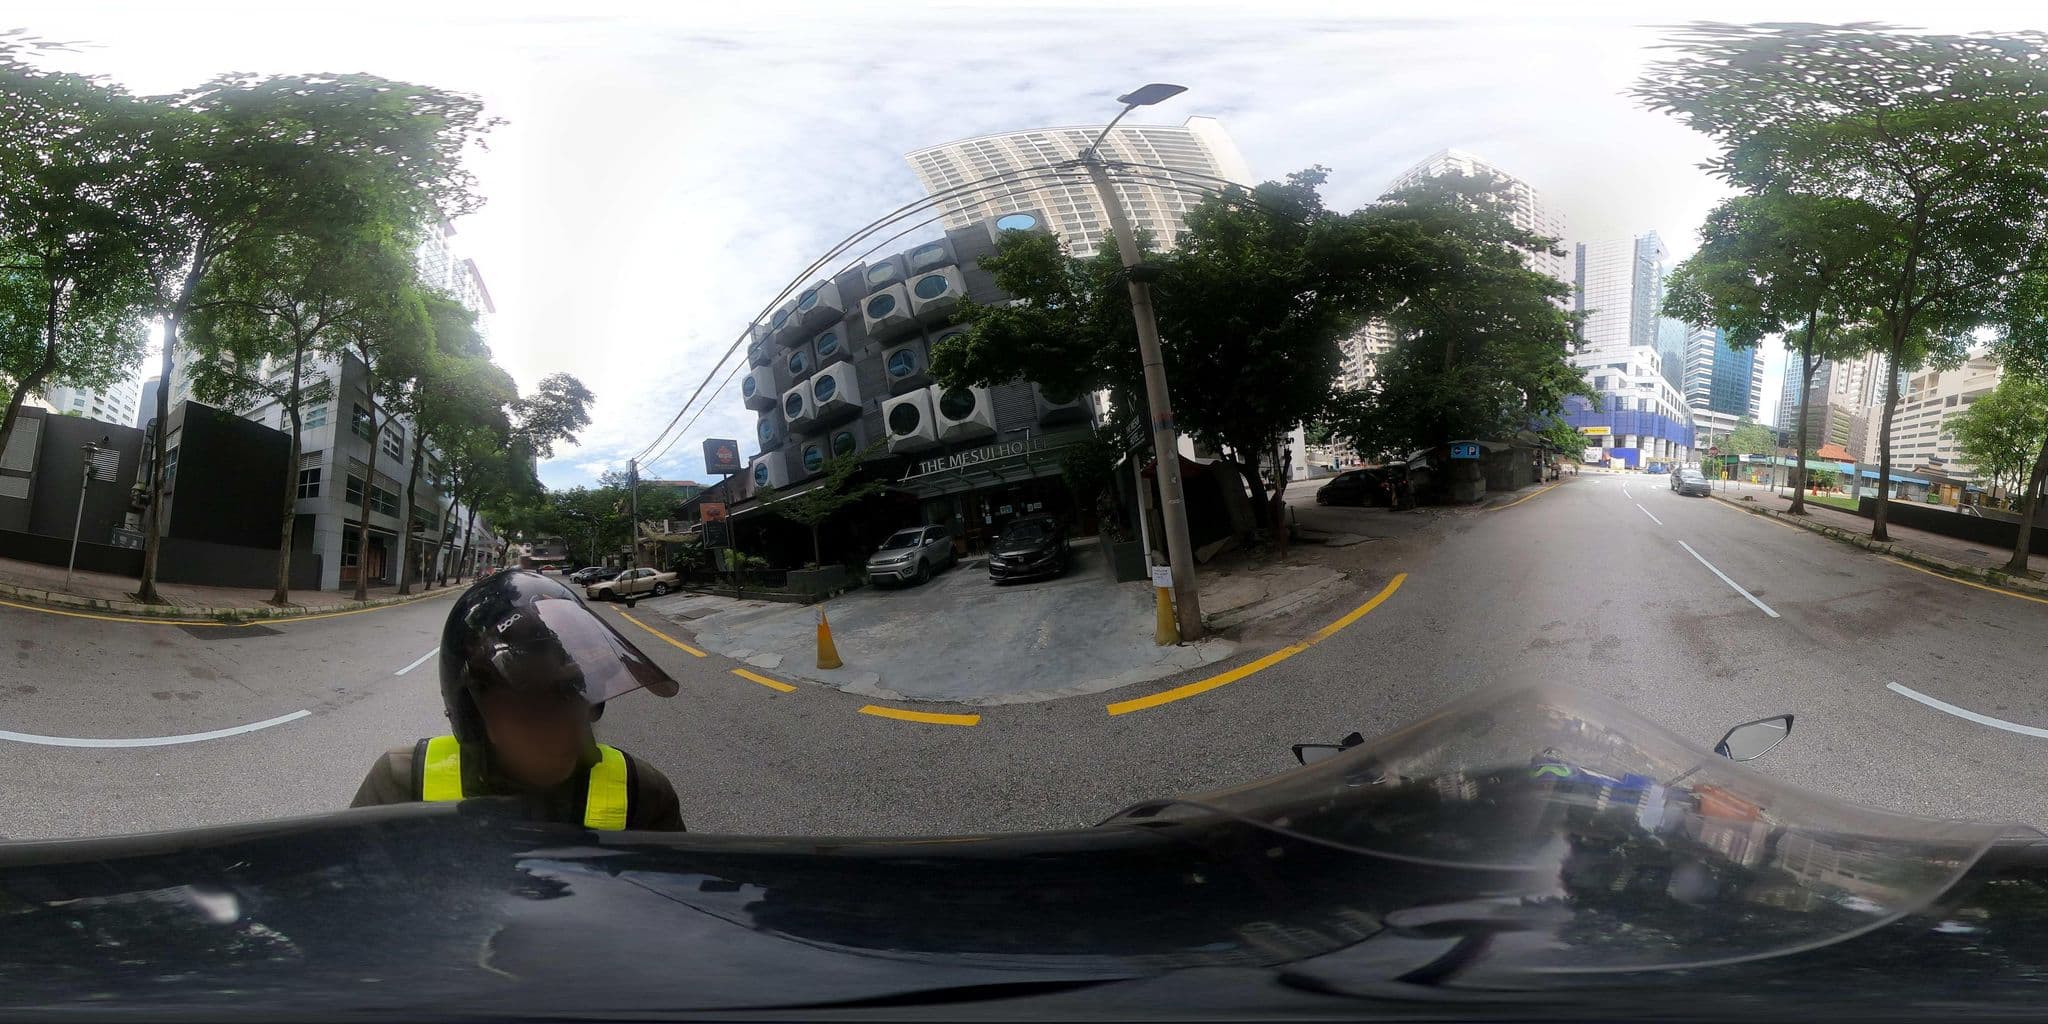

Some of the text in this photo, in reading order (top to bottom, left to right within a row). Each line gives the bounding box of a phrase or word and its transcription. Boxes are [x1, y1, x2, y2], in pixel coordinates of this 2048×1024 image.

[1468, 446, 1476, 455] P
[919, 457, 945, 475] THE
[949, 447, 996, 469] MESUI
